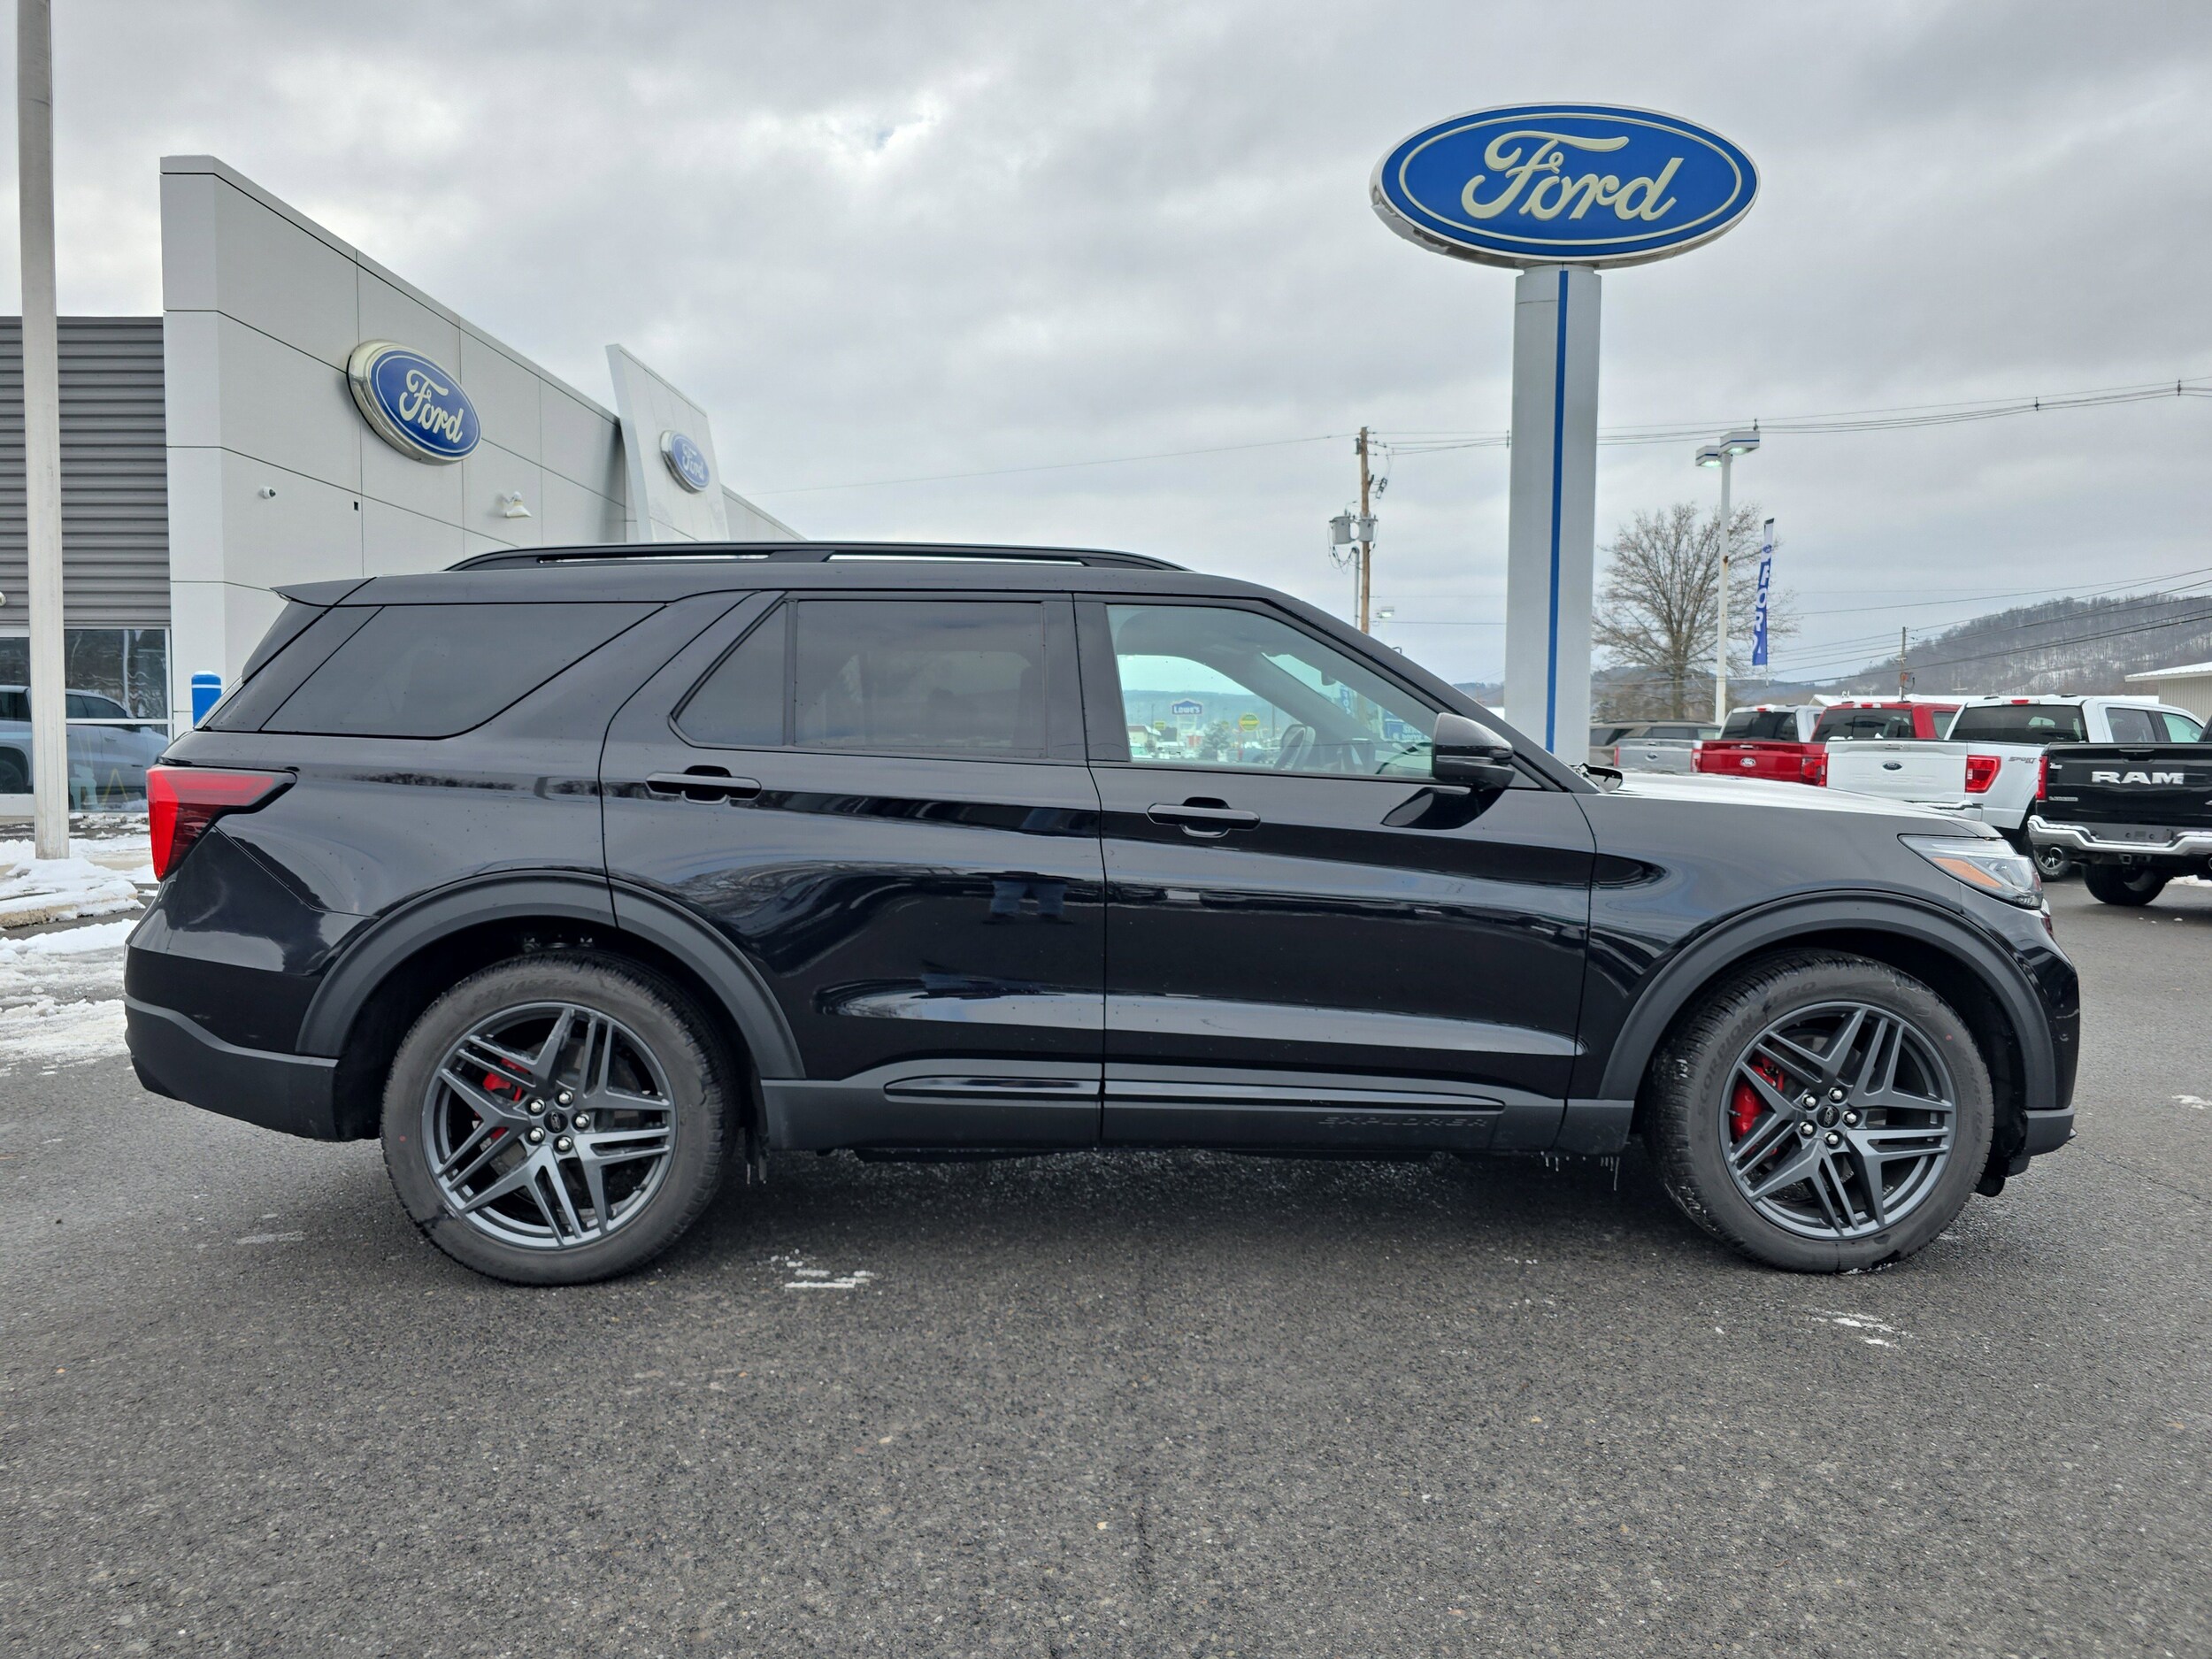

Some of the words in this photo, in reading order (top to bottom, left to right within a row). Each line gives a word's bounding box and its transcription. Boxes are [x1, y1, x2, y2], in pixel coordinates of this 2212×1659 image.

[1461, 129, 1685, 222] Ford
[398, 368, 465, 444] Ford
[681, 443, 705, 479] Ford
[2091, 771, 2185, 785] RAM
[1697, 1012, 1754, 1117] SCORPION
[1317, 1116, 1487, 1127] EXPLORER
